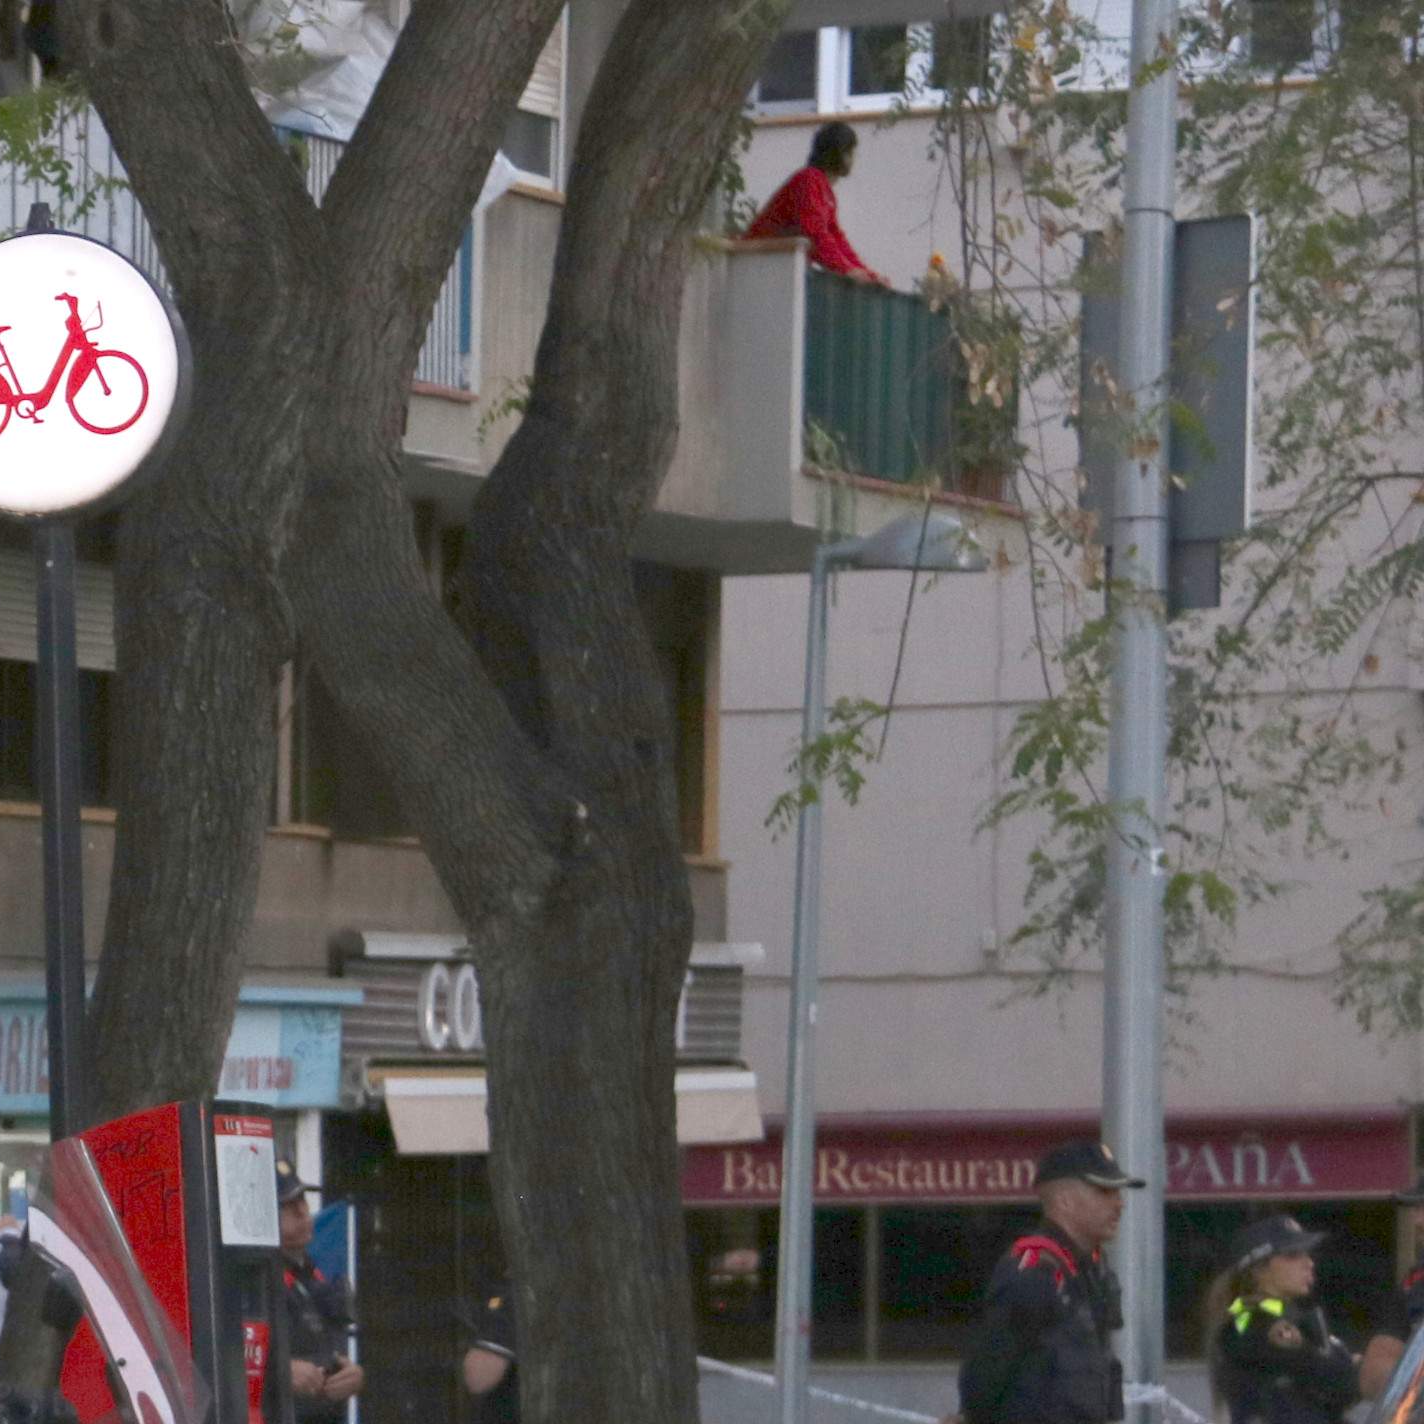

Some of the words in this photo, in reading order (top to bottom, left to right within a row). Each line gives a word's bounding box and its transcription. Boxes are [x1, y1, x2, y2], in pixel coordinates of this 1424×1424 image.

[722, 1151, 782, 1192] Ba
[817, 1150, 1038, 1191] Restauran
[1164, 1132, 1314, 1187] PAÑA
